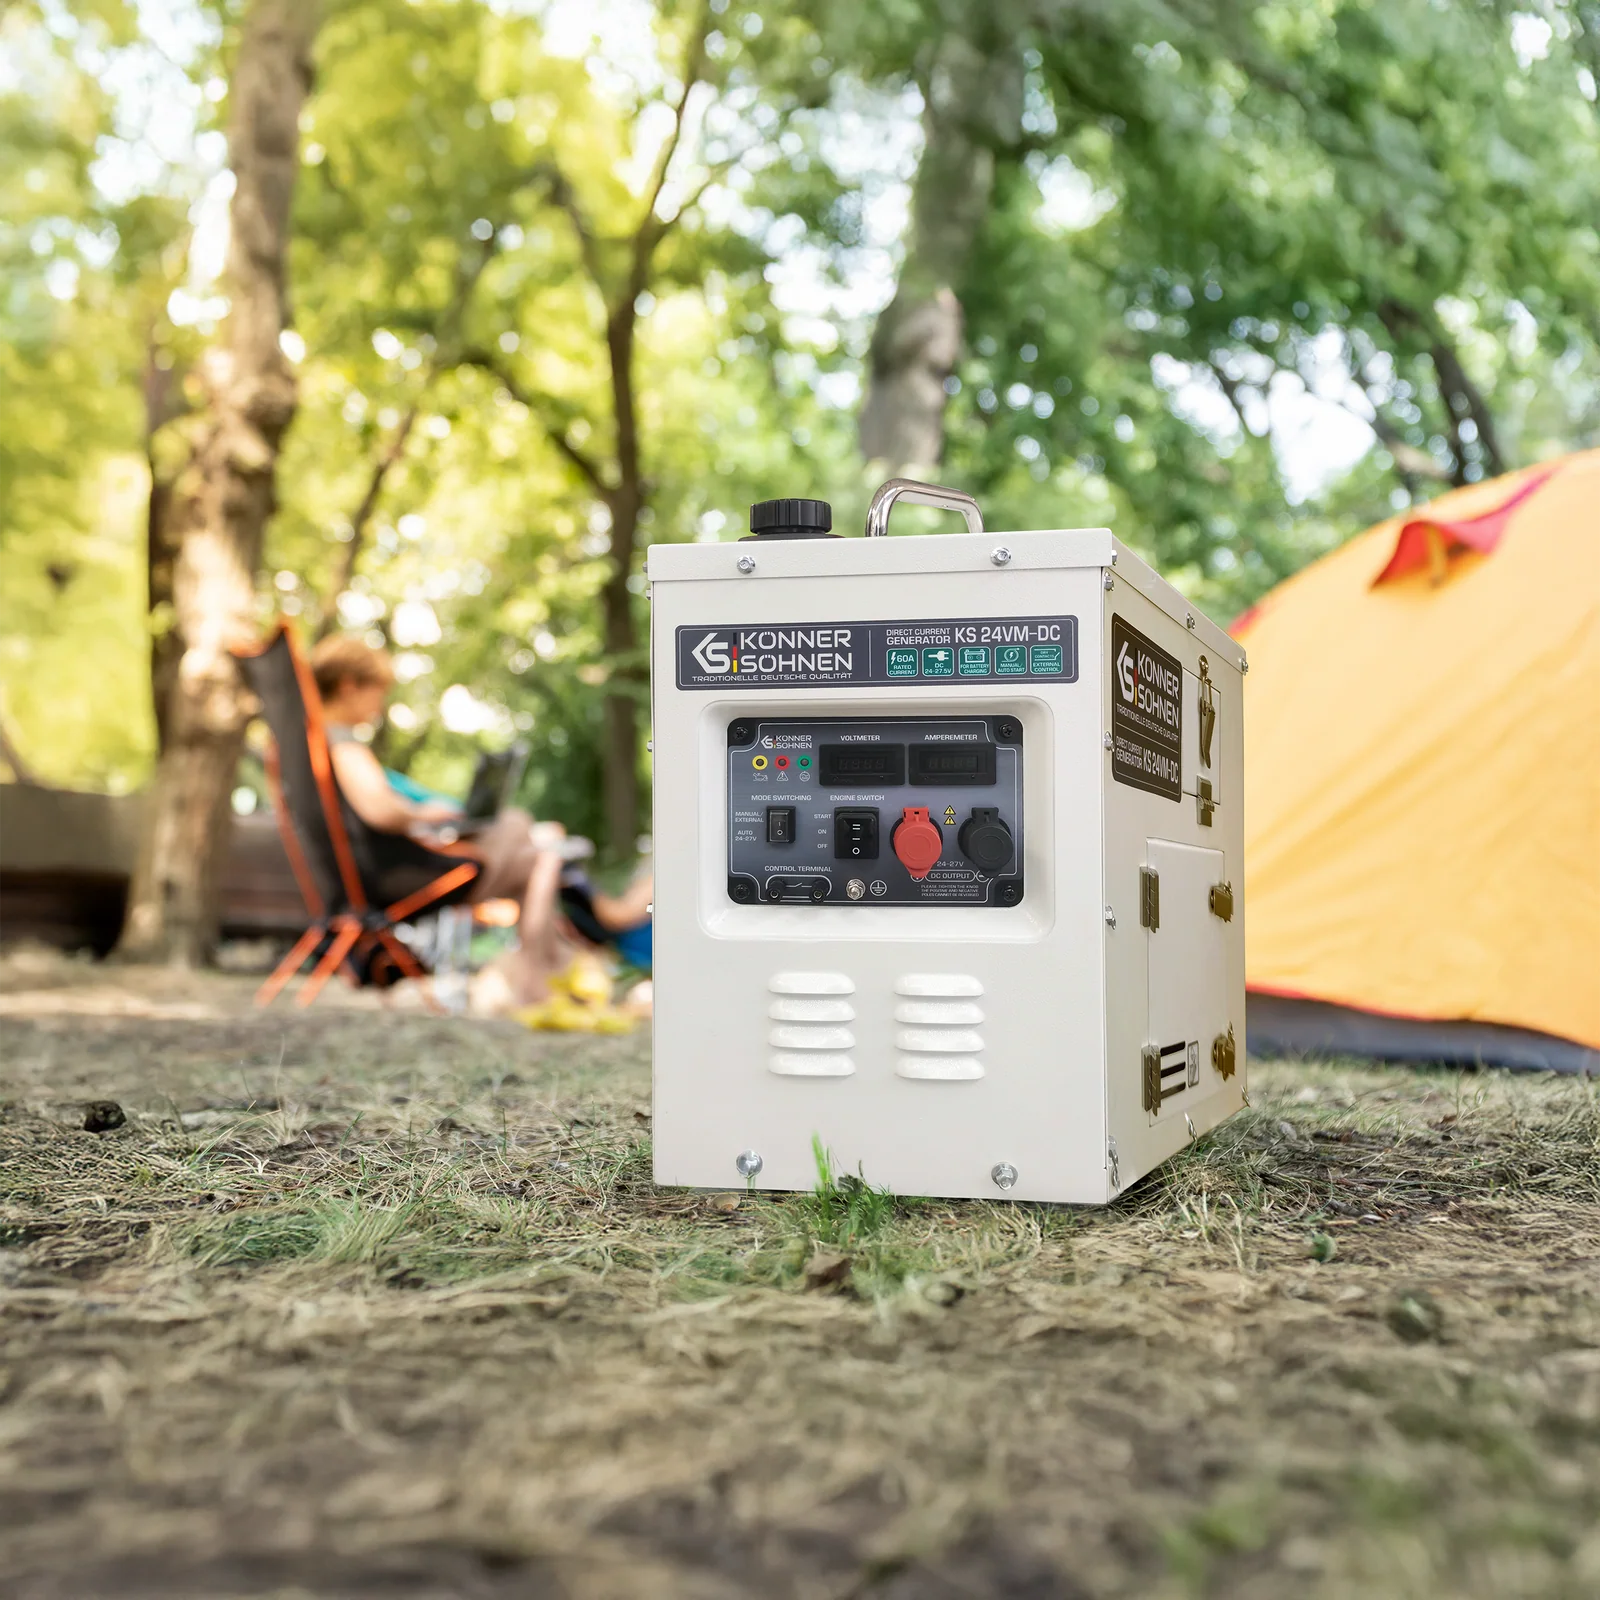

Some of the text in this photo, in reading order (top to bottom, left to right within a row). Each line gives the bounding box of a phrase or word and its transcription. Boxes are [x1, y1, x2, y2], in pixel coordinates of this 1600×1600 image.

[740, 629, 852, 650] KÖNNER
[886, 627, 951, 636] DIRECT CURRENT
[886, 635, 951, 645] GENERATOR
[955, 625, 1061, 643] KS 24VM-DC
[740, 652, 853, 673] SÖHNEN
[896, 654, 915, 663] 60A
[692, 672, 853, 682] TRADITIONELLE DEUTSCHE QUALITÄT
[1116, 747, 1143, 770] GENERATOR
[1143, 747, 1179, 784] KS 24VM-DC
